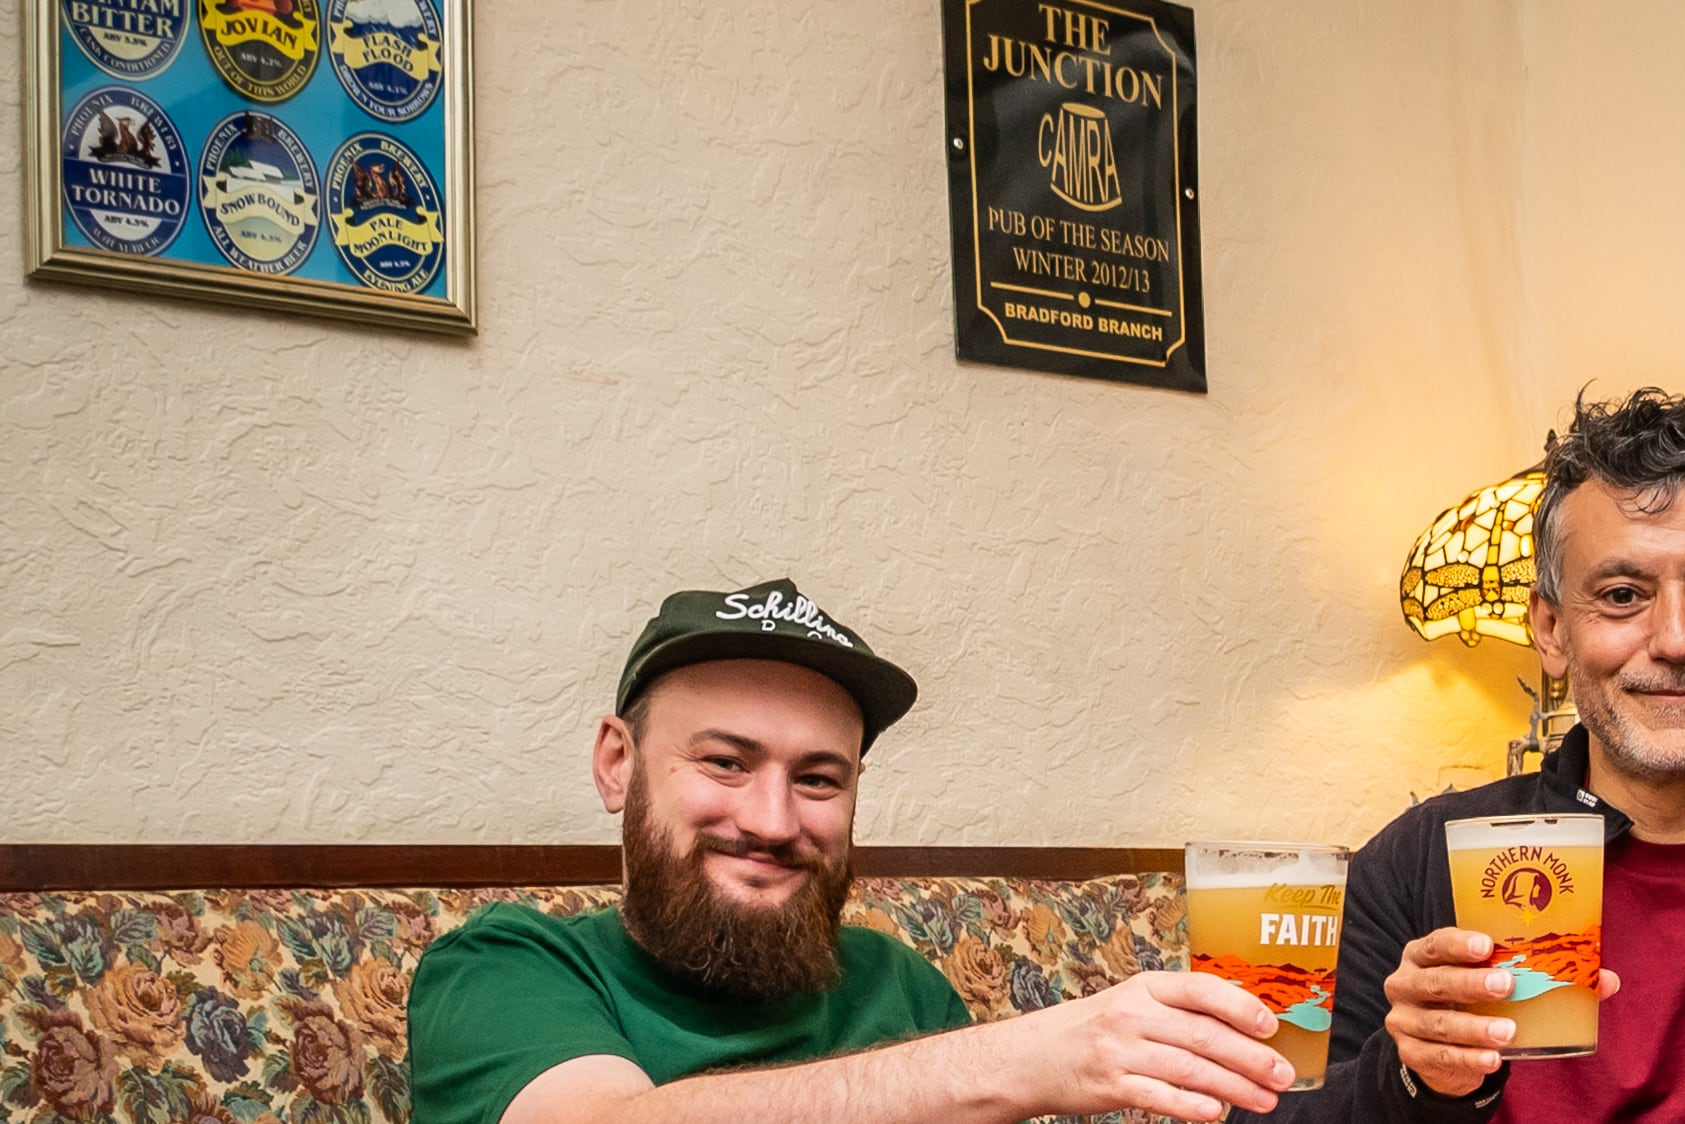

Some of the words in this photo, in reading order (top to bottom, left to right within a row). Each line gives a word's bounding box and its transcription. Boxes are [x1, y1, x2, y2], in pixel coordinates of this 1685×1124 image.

[72, 1, 174, 39] BITTER
[221, 17, 297, 50] JOVIAN
[1038, 4, 1111, 56] THE
[104, 42, 171, 72] CONDITIONED
[363, 34, 413, 58] FLASH
[363, 48, 414, 72] FLOOD
[214, 46, 232, 72] OUT
[230, 71, 244, 85] OF
[247, 83, 275, 97] THIS
[274, 66, 306, 95] WORLD
[983, 34, 1164, 111] JUNCTION
[369, 98, 397, 117] YOUR
[396, 82, 434, 117] SORROWS
[71, 95, 114, 137] PHOENIX
[131, 97, 178, 150] BREWERY
[205, 122, 238, 172] PHOENIX
[277, 128, 314, 188] BREWERY
[332, 141, 363, 191] PHOENIX
[380, 140, 428, 188] BREWERY
[1038, 108, 1122, 205] CAMRA
[89, 168, 161, 194] WHITE
[71, 184, 181, 216] TORNADO
[220, 193, 300, 226] SNOWBOUND
[104, 214, 123, 225] ABV
[369, 216, 404, 232] PALE
[988, 206, 1027, 237] PUB
[1030, 218, 1055, 242] OF
[1059, 220, 1097, 249] THE
[1100, 229, 1170, 264] SEASON
[213, 226, 231, 250] ALL
[229, 246, 286, 273] WEATHER
[285, 240, 307, 269] BEER
[354, 229, 428, 255] MOONLIGHT
[362, 268, 411, 293] EVENING
[410, 268, 428, 286] ALE
[1012, 246, 1088, 284] WINTER
[1090, 261, 1151, 294] 2012/13
[1005, 302, 1094, 331] BRADFORD
[1098, 318, 1163, 341] BRANCH
[1480, 845, 1543, 898] NORTHERN
[1542, 852, 1575, 895] MONK
[1263, 882, 1316, 909] Keep
[1259, 912, 1339, 946] FAITH
